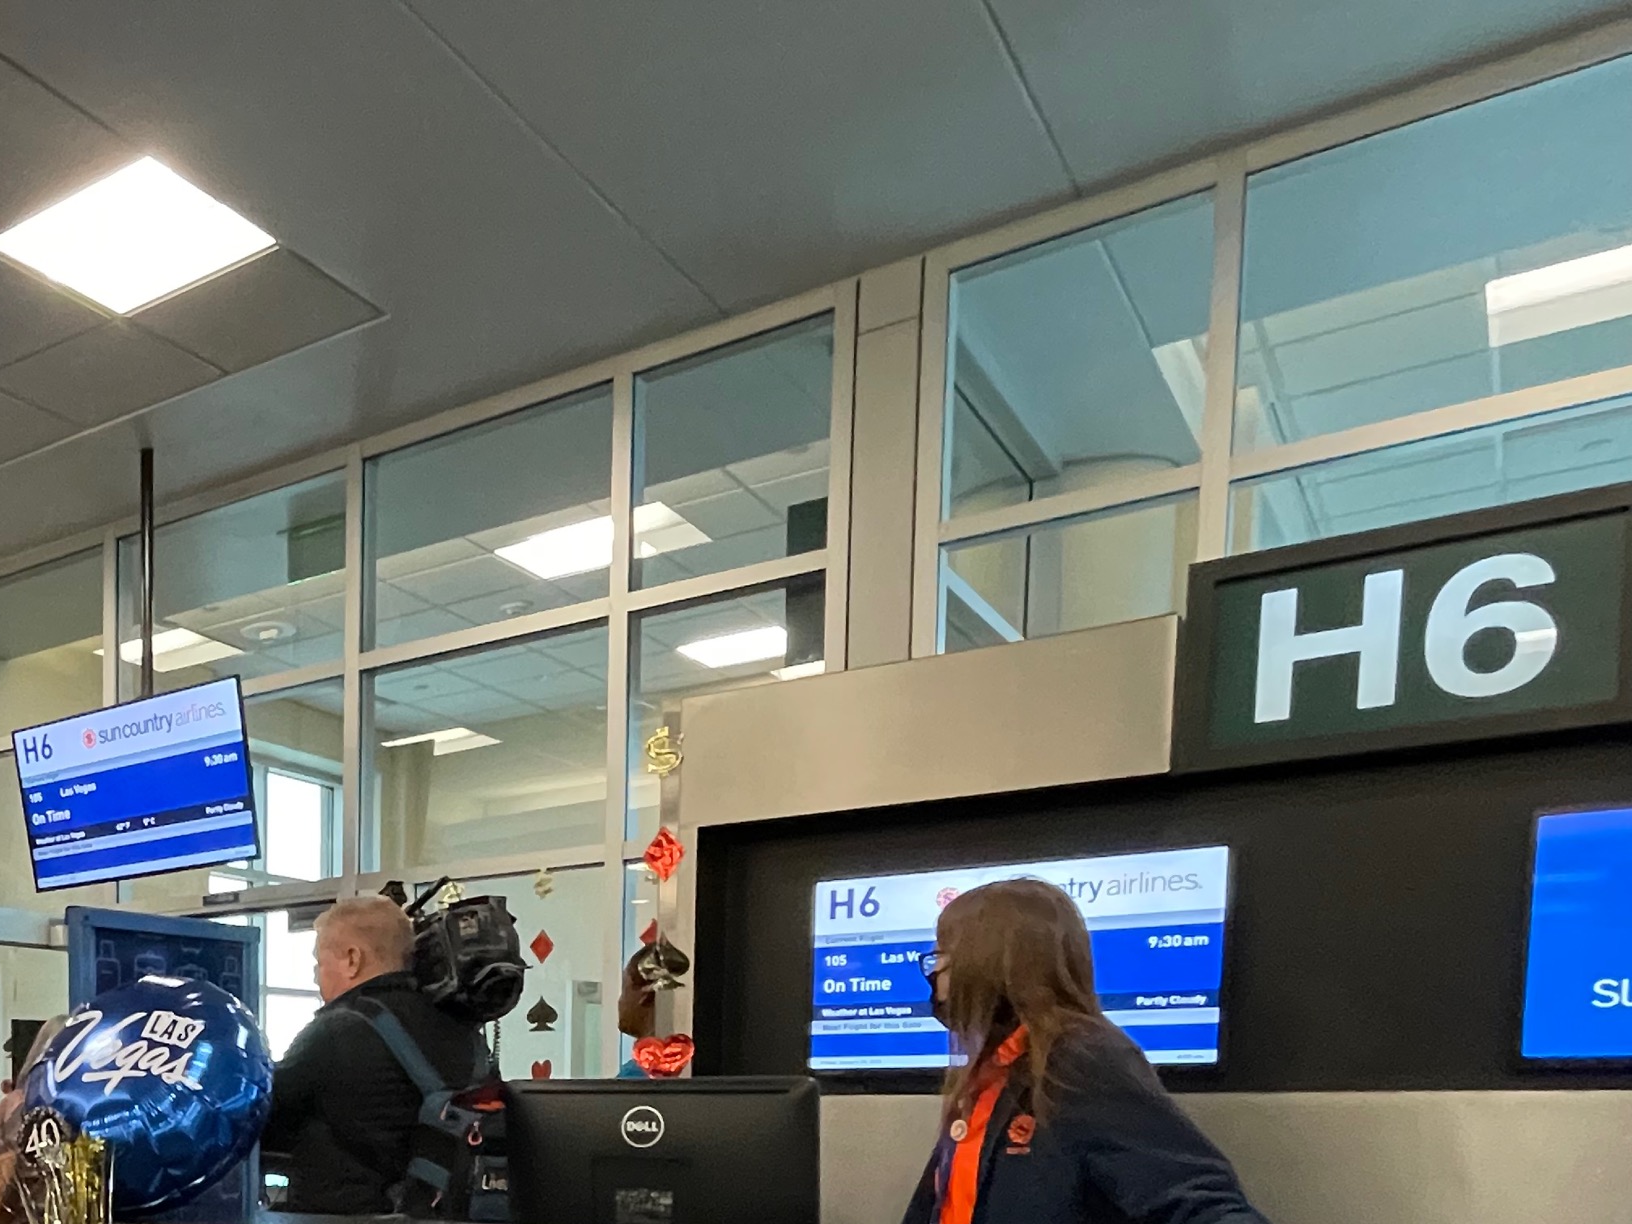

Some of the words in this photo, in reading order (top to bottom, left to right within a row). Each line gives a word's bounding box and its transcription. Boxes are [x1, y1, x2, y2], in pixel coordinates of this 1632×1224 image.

[1255, 552, 1558, 724] H6
[23, 733, 53, 764] H6
[32, 813, 46, 826] On
[46, 809, 71, 823] Time
[830, 886, 880, 920] H6
[825, 955, 847, 967] 105
[881, 952, 904, 964] Las
[1148, 935, 1182, 948] 9:30
[1183, 935, 1210, 948] am
[824, 979, 846, 993] On
[849, 977, 892, 992] Time
[149, 1014, 198, 1041] LAS
[53, 1010, 204, 1097] Vegas
[25, 1118, 61, 1153] 40
[626, 1121, 659, 1132] DELL
